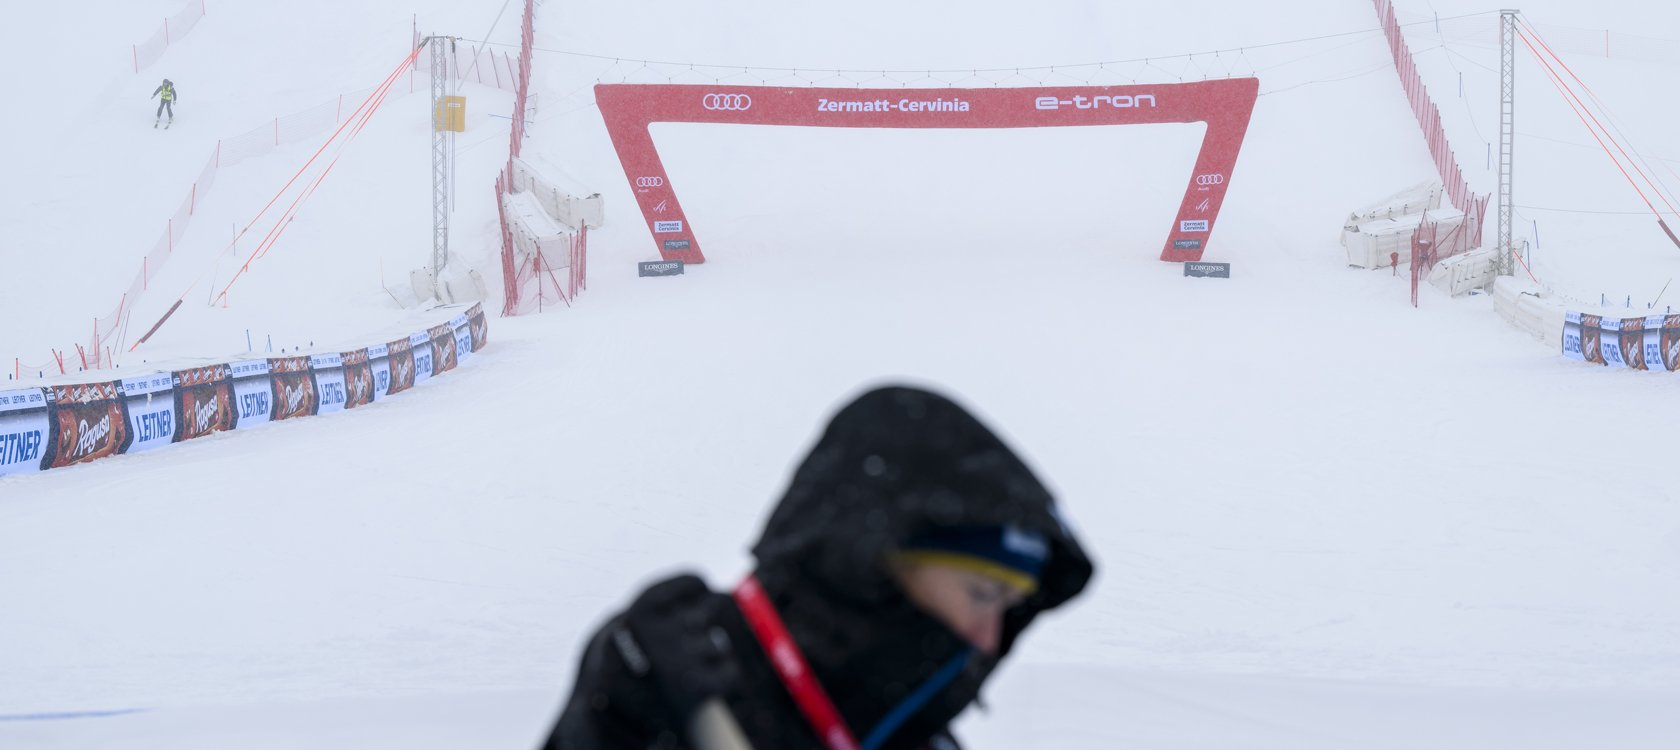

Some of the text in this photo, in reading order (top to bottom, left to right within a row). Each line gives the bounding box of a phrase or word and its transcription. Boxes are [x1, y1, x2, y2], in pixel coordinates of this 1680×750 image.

[817, 98, 970, 113] Zermatt-Cervinia
[1035, 94, 1156, 110] e-tron
[644, 262, 679, 271] LONGINES
[1190, 264, 1225, 272] LONGINES
[195, 395, 218, 433] Ragusa
[240, 391, 268, 419] LEITNER
[73, 414, 110, 457] Ragusa
[136, 409, 172, 443] LEITNER
